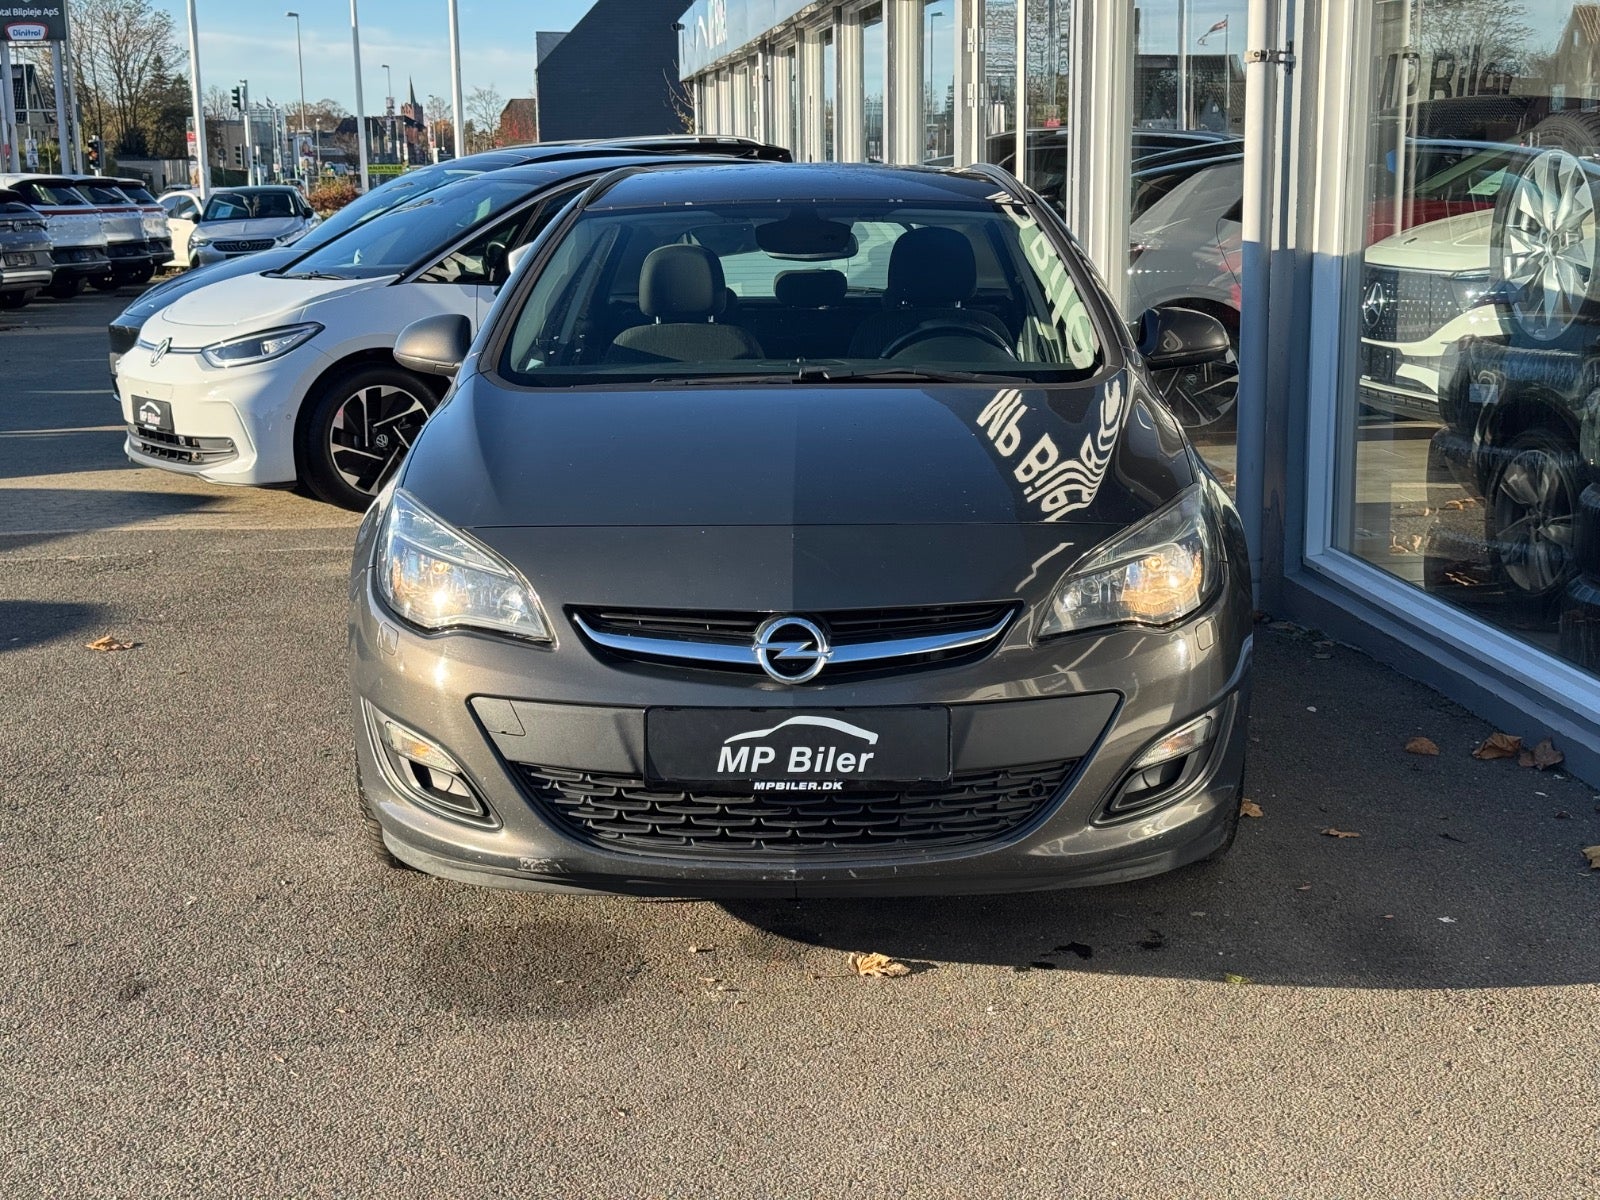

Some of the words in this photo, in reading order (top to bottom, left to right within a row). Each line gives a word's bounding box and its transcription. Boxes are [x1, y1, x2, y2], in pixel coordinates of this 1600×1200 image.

[0, 7, 12, 17] tal
[12, 7, 42, 18] Bilpleje
[42, 7, 60, 18] ApS
[12, 29, 41, 37] Dinitrol
[716, 746, 776, 773] MP
[787, 746, 875, 773] Biler
[753, 781, 844, 791] MPBILER.DK
